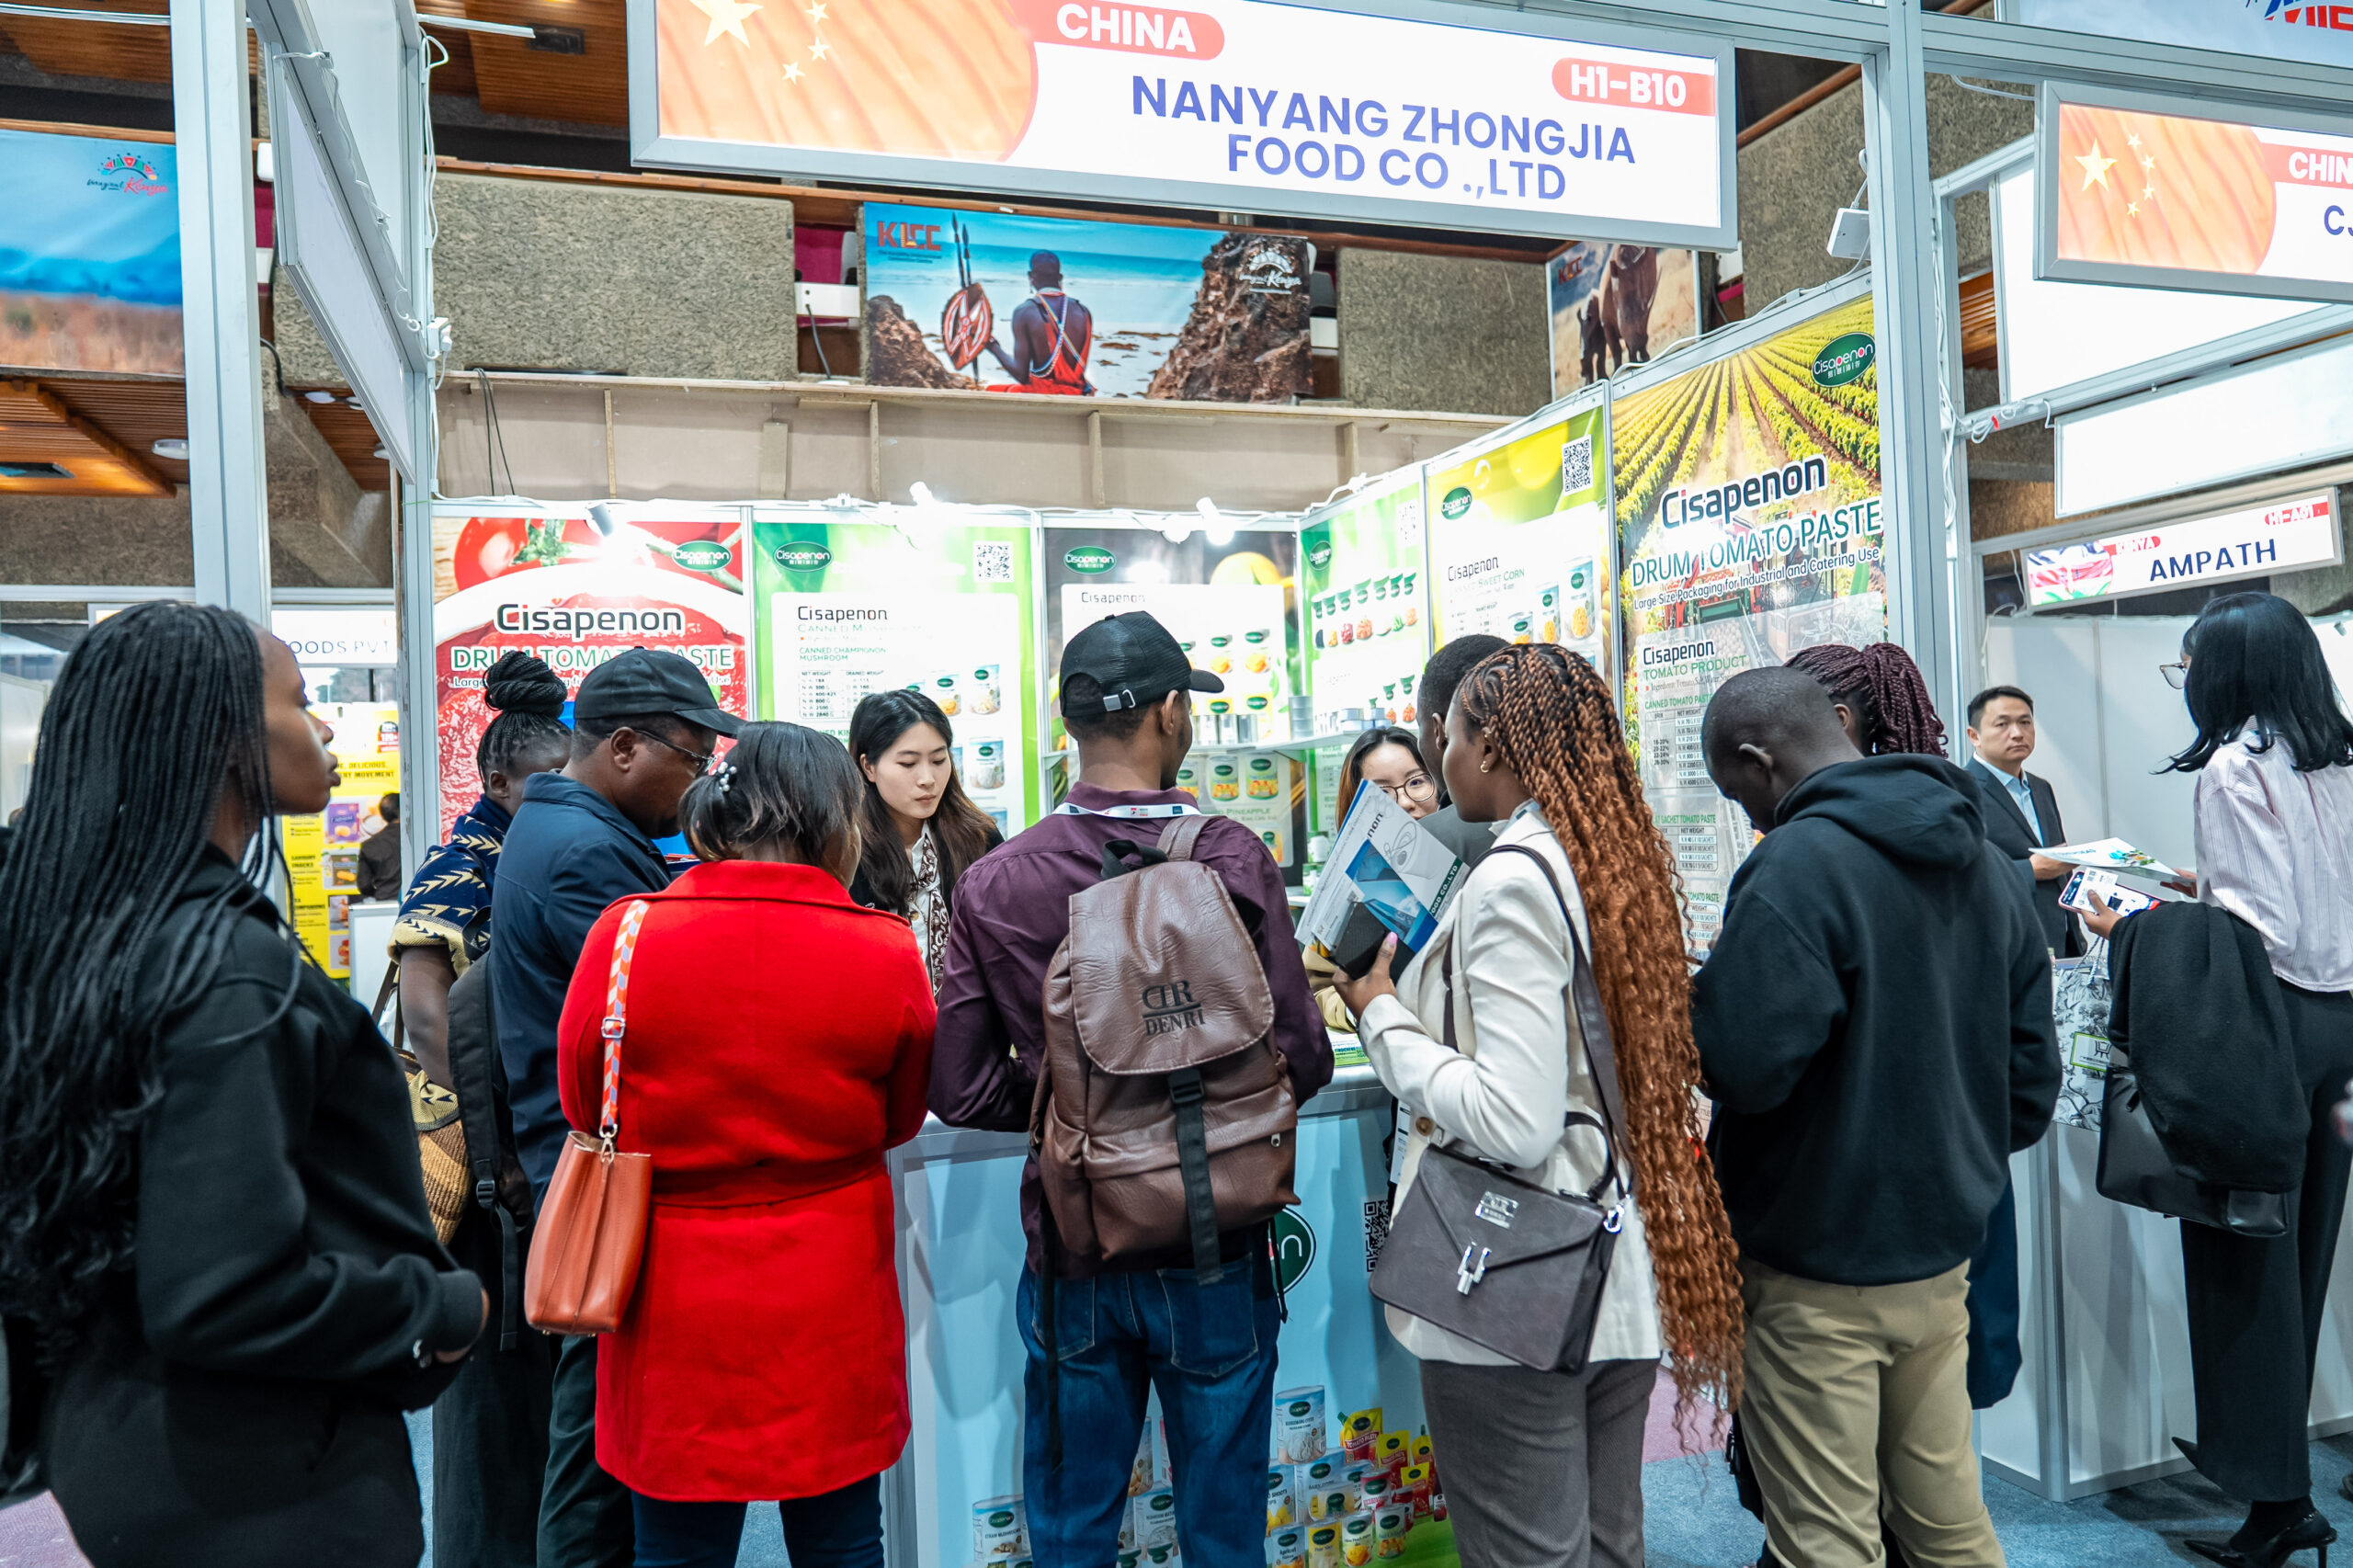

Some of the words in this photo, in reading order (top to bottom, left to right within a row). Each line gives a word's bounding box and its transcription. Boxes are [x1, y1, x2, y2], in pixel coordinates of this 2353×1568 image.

[1057, 3, 1197, 53] CHINA
[1570, 63, 1688, 108] H1-B10
[1131, 74, 1390, 138] NANYANG
[1402, 104, 1636, 165] ZHONGJIA
[1227, 134, 1366, 182] FOOD
[123, 176, 168, 197] Kenya
[877, 220, 943, 252] KICC
[1813, 343, 1874, 375] Cisapenon
[1661, 456, 1826, 529] Cisapenon
[674, 549, 730, 560] Cisapenon
[776, 550, 831, 561] Cisapenon
[1632, 550, 1690, 587] DRUM
[1698, 524, 1793, 571] TOMATO
[1801, 499, 1881, 548] PASTE
[1065, 553, 1115, 563] Cisapenon
[1448, 556, 1499, 582] Cisapenon
[2149, 539, 2277, 582] AMPATH
[1503, 568, 1525, 581] CORN
[1633, 596, 1657, 610] Large
[1658, 593, 1676, 605] Size
[1677, 582, 1723, 600] Packaging
[1724, 578, 1738, 590] for
[1740, 566, 1785, 585] Industrial
[1787, 561, 1807, 576] and
[1809, 552, 1856, 572] Catering
[1858, 546, 1880, 562] Use
[1081, 592, 1146, 604] Cisapenon
[497, 603, 682, 638] Cisapenon
[798, 606, 889, 623] Cisapenon
[289, 641, 347, 653] OODS
[1643, 641, 1715, 665] Cisapenon
[1643, 664, 1688, 680] TOMATO
[1691, 654, 1746, 675] PRODUCT
[1644, 699, 1668, 710] CANNED
[1669, 697, 1694, 706] TOMATO
[1680, 815, 1700, 824] TOMATO
[1700, 814, 1717, 824] PASTE
[1430, 896, 1442, 914] OOD
[1705, 892, 1721, 903] PASTE
[1144, 1008, 1206, 1036] DENRI
